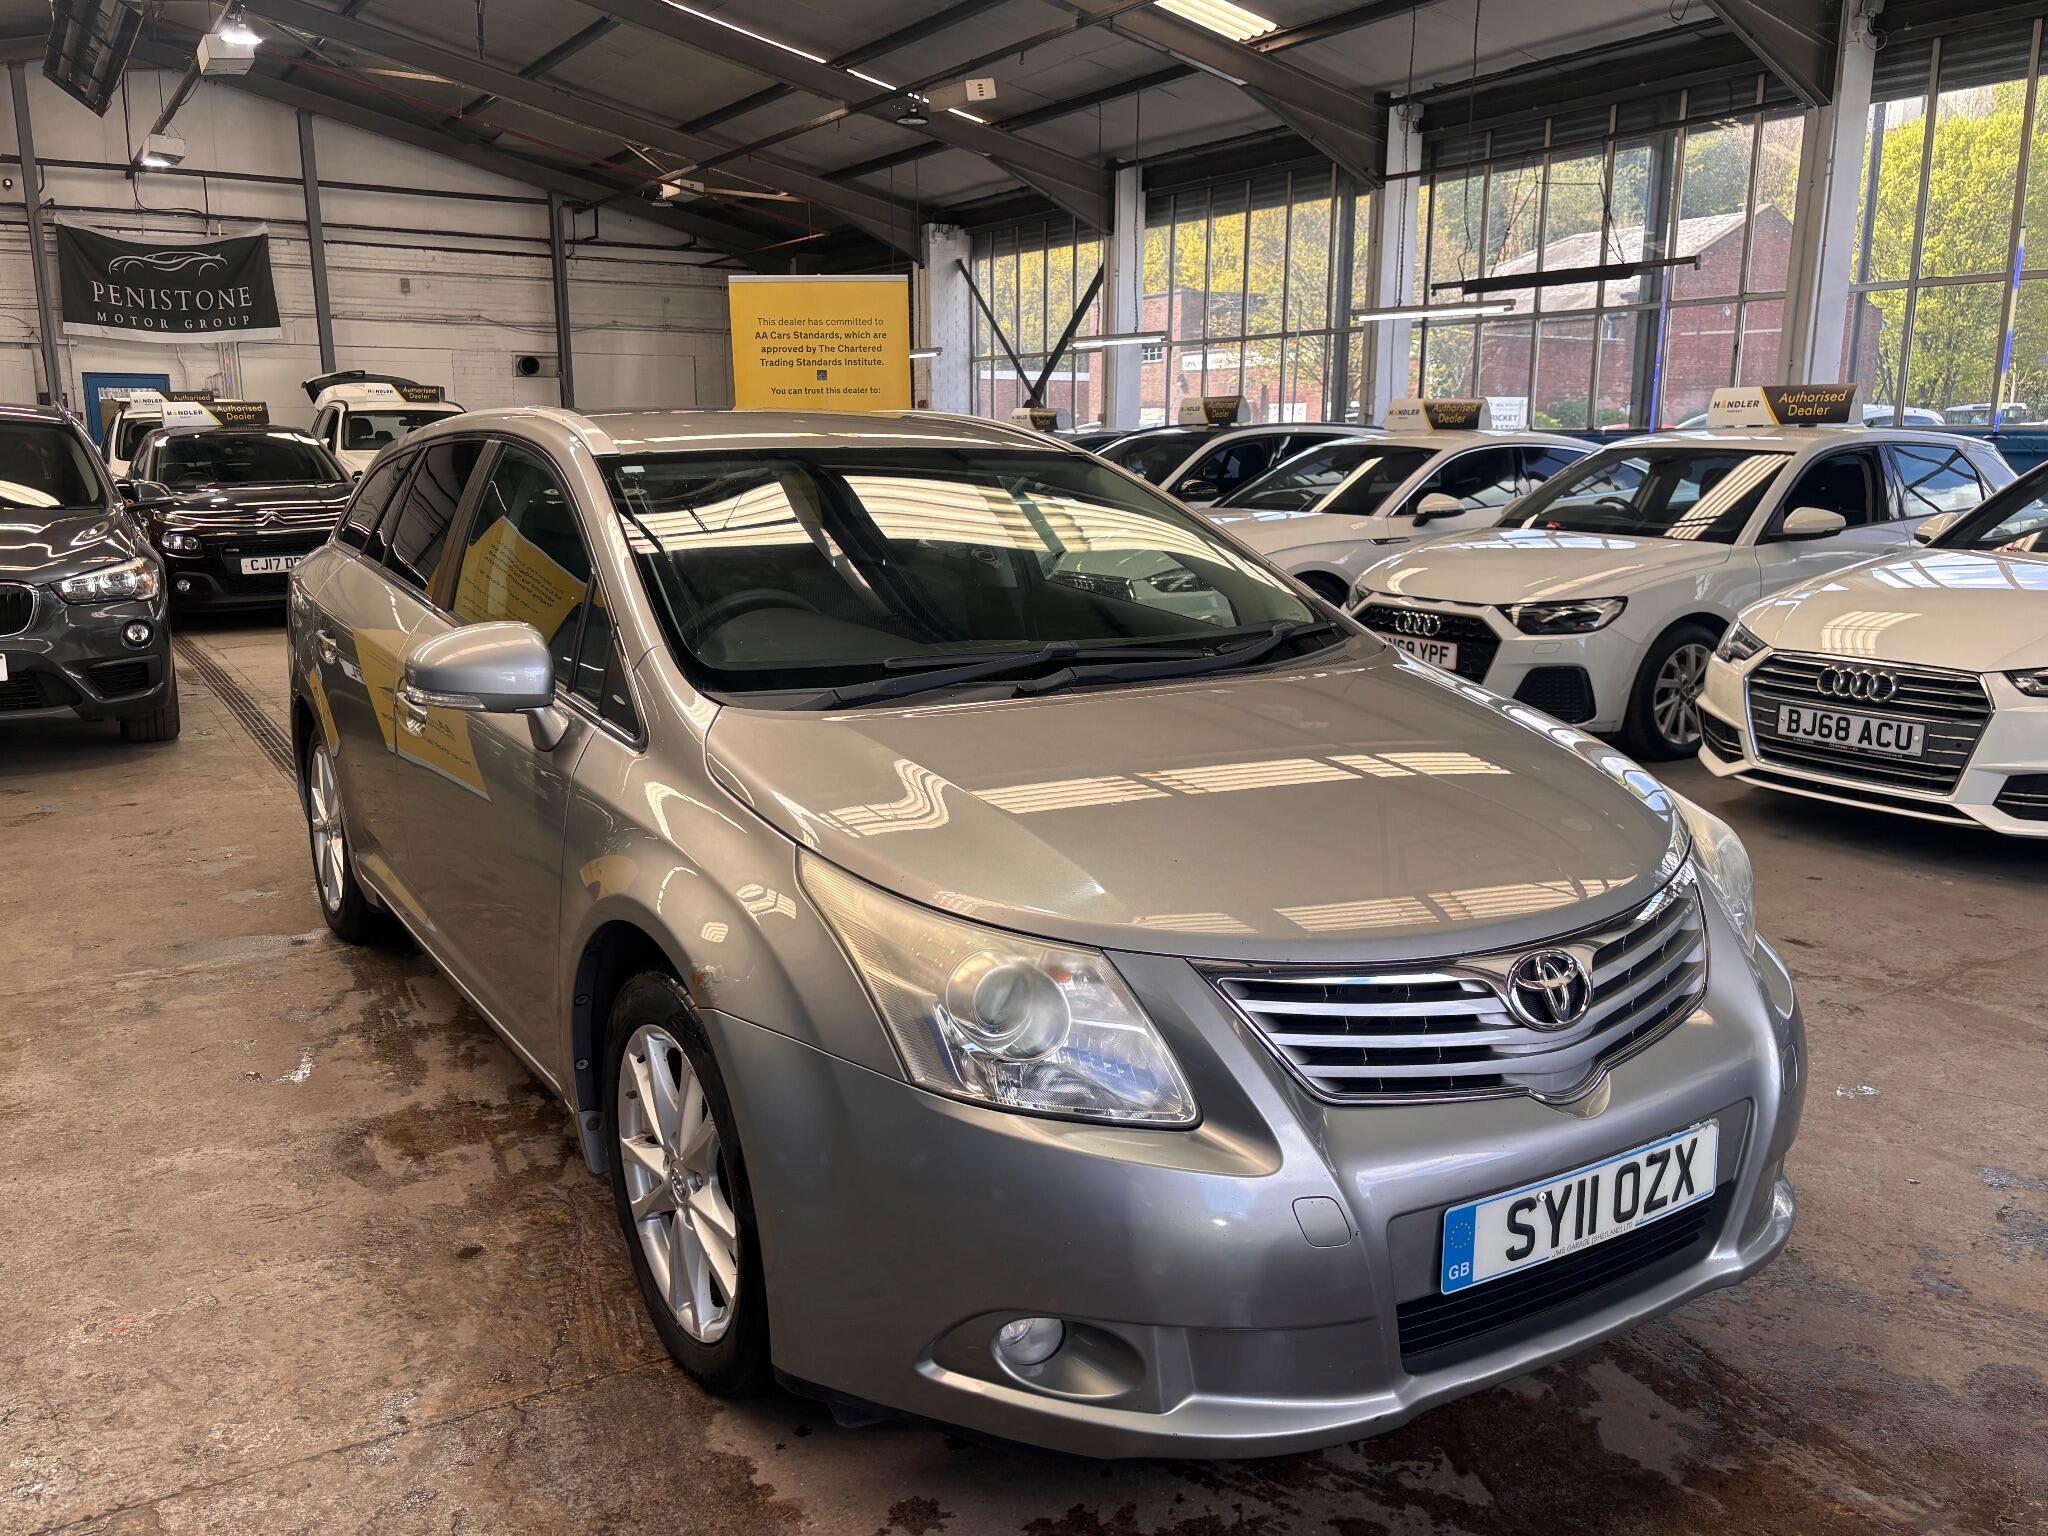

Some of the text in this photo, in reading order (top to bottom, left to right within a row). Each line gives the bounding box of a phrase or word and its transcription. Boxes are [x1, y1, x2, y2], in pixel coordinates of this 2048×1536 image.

[91, 280, 252, 311] PENISTONE
[97, 312, 250, 329] MOTOR GROUP
[757, 318, 884, 326] This dealer has committed to
[755, 332, 768, 340] AA
[770, 332, 791, 340] Cars
[793, 331, 842, 340] Standards,
[844, 331, 870, 339] which
[761, 345, 804, 354] approved
[806, 345, 816, 354] by
[838, 344, 882, 352] Chartered
[760, 358, 885, 367] Trading Standards Institute.
[771, 387, 786, 395] You
[1778, 390, 1848, 404] Authorised
[217, 404, 263, 412] Authorised
[1432, 403, 1477, 413] Authorised
[1788, 403, 1830, 416] Dealer
[1438, 413, 1467, 424] Dealer
[250, 558, 281, 571] CJ17
[1419, 642, 1450, 665] YPF
[1786, 708, 1914, 751] BJ68 ACU
[1505, 1138, 1698, 1262] SY11 OZX
[1447, 1261, 1471, 1281] GB
